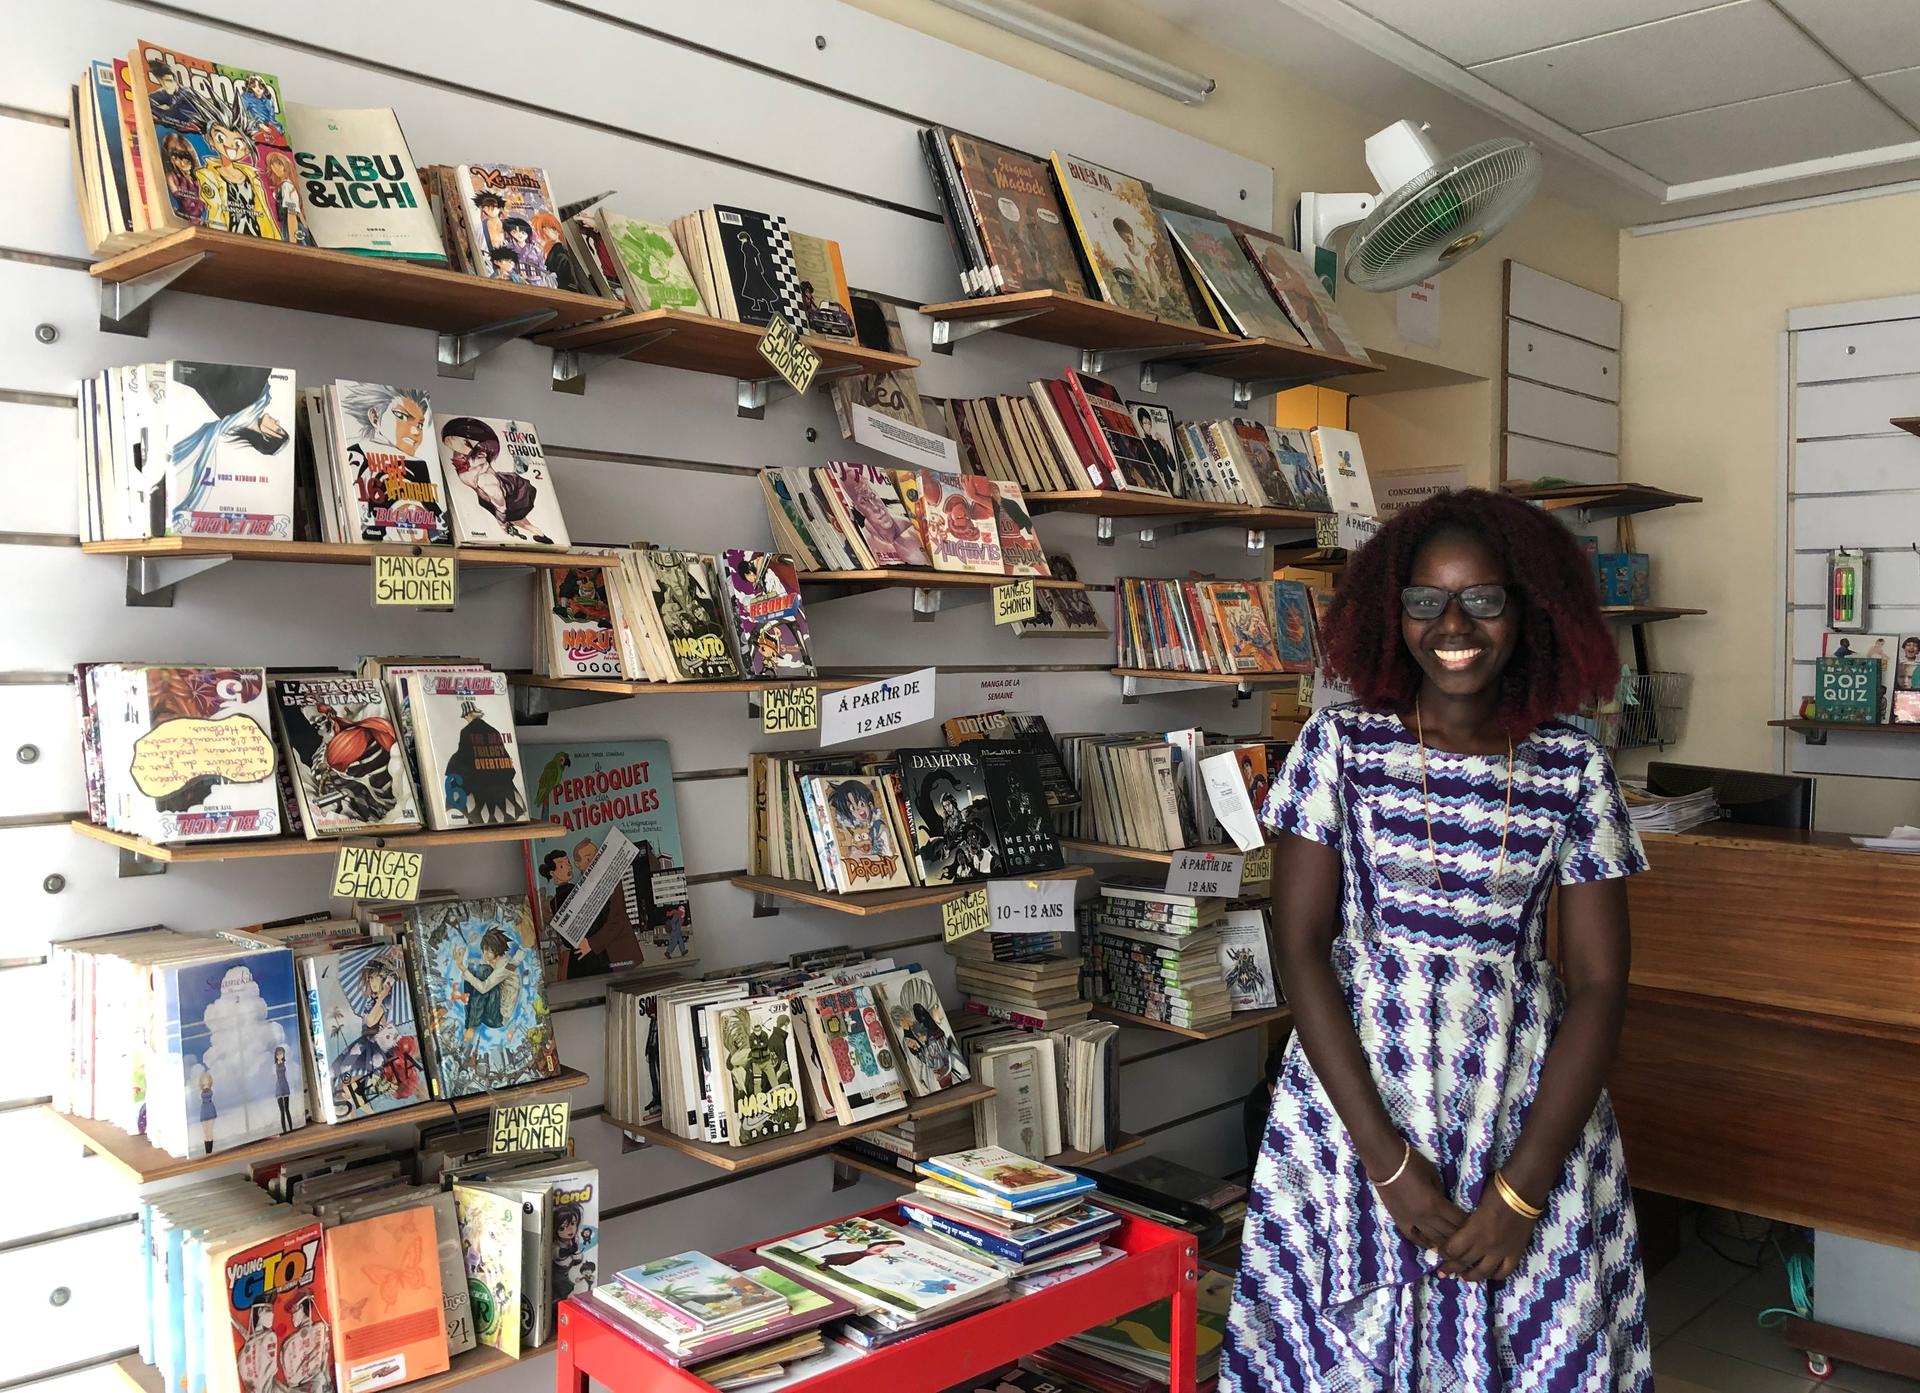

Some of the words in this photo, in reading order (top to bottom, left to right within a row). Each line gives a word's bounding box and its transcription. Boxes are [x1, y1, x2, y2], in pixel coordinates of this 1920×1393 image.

[294, 151, 405, 182] SABU
[305, 180, 418, 209] &ICHI
[771, 318, 816, 372] MANGAS
[762, 332, 810, 391] SHONEN
[502, 430, 537, 445] TOKYO
[507, 444, 544, 459] GHOUL
[200, 466, 216, 487] 7
[532, 469, 543, 480] 2
[353, 476, 385, 503] 16
[191, 517, 273, 536] BLEACH
[374, 507, 436, 525] BLEACH
[379, 556, 450, 578] MANGAS
[377, 579, 452, 601] SHONEN
[999, 581, 1031, 600] MANGAS
[999, 596, 1032, 616] SHONEN
[673, 637, 726, 663] NARUTO
[283, 680, 376, 695] L'ATTAQUE
[433, 676, 493, 691] BLEACH
[980, 680, 1004, 689] MANGA
[1013, 679, 1020, 687] LA
[1822, 673, 1869, 689] POP
[283, 694, 317, 707] DES
[322, 691, 383, 705] TITANS
[766, 687, 815, 709] MANGAS
[852, 684, 900, 709] PARTIR
[904, 681, 920, 697] DE
[987, 691, 1014, 701] SEMAINE
[1823, 689, 1868, 703] QUIZ
[765, 704, 816, 730] SHONEN
[856, 718, 872, 734] 12
[876, 711, 902, 729] ANS
[474, 757, 515, 770] OVERTURE
[912, 753, 975, 770] DAMPYR
[444, 773, 468, 810] 6
[552, 761, 650, 806] PERROQUET
[176, 813, 260, 836] BLEACH
[1004, 832, 1051, 845] METAL
[1007, 843, 1054, 856] BRAIN
[343, 847, 420, 878] MANGAS
[841, 855, 899, 886] DOROTHY
[1188, 858, 1220, 873] PARTIR
[1220, 861, 1233, 873] DE
[1244, 861, 1270, 879] SEINEN
[337, 872, 409, 899] SHOJO
[1187, 881, 1199, 893] 12
[1199, 881, 1218, 893] ANS
[559, 884, 581, 917] PERROQUET
[946, 890, 986, 918] MANGAS
[997, 905, 1011, 919] 10
[1023, 904, 1037, 918] 12
[1040, 903, 1063, 918] ANS
[558, 913, 571, 928] TOME
[946, 905, 989, 937] SHONEN
[737, 1086, 797, 1119] NARUTO
[495, 1104, 565, 1131] MANGAS
[494, 1125, 565, 1152] SHONEN
[526, 1203, 532, 1212] 3
[227, 1257, 264, 1290] YOUNG
